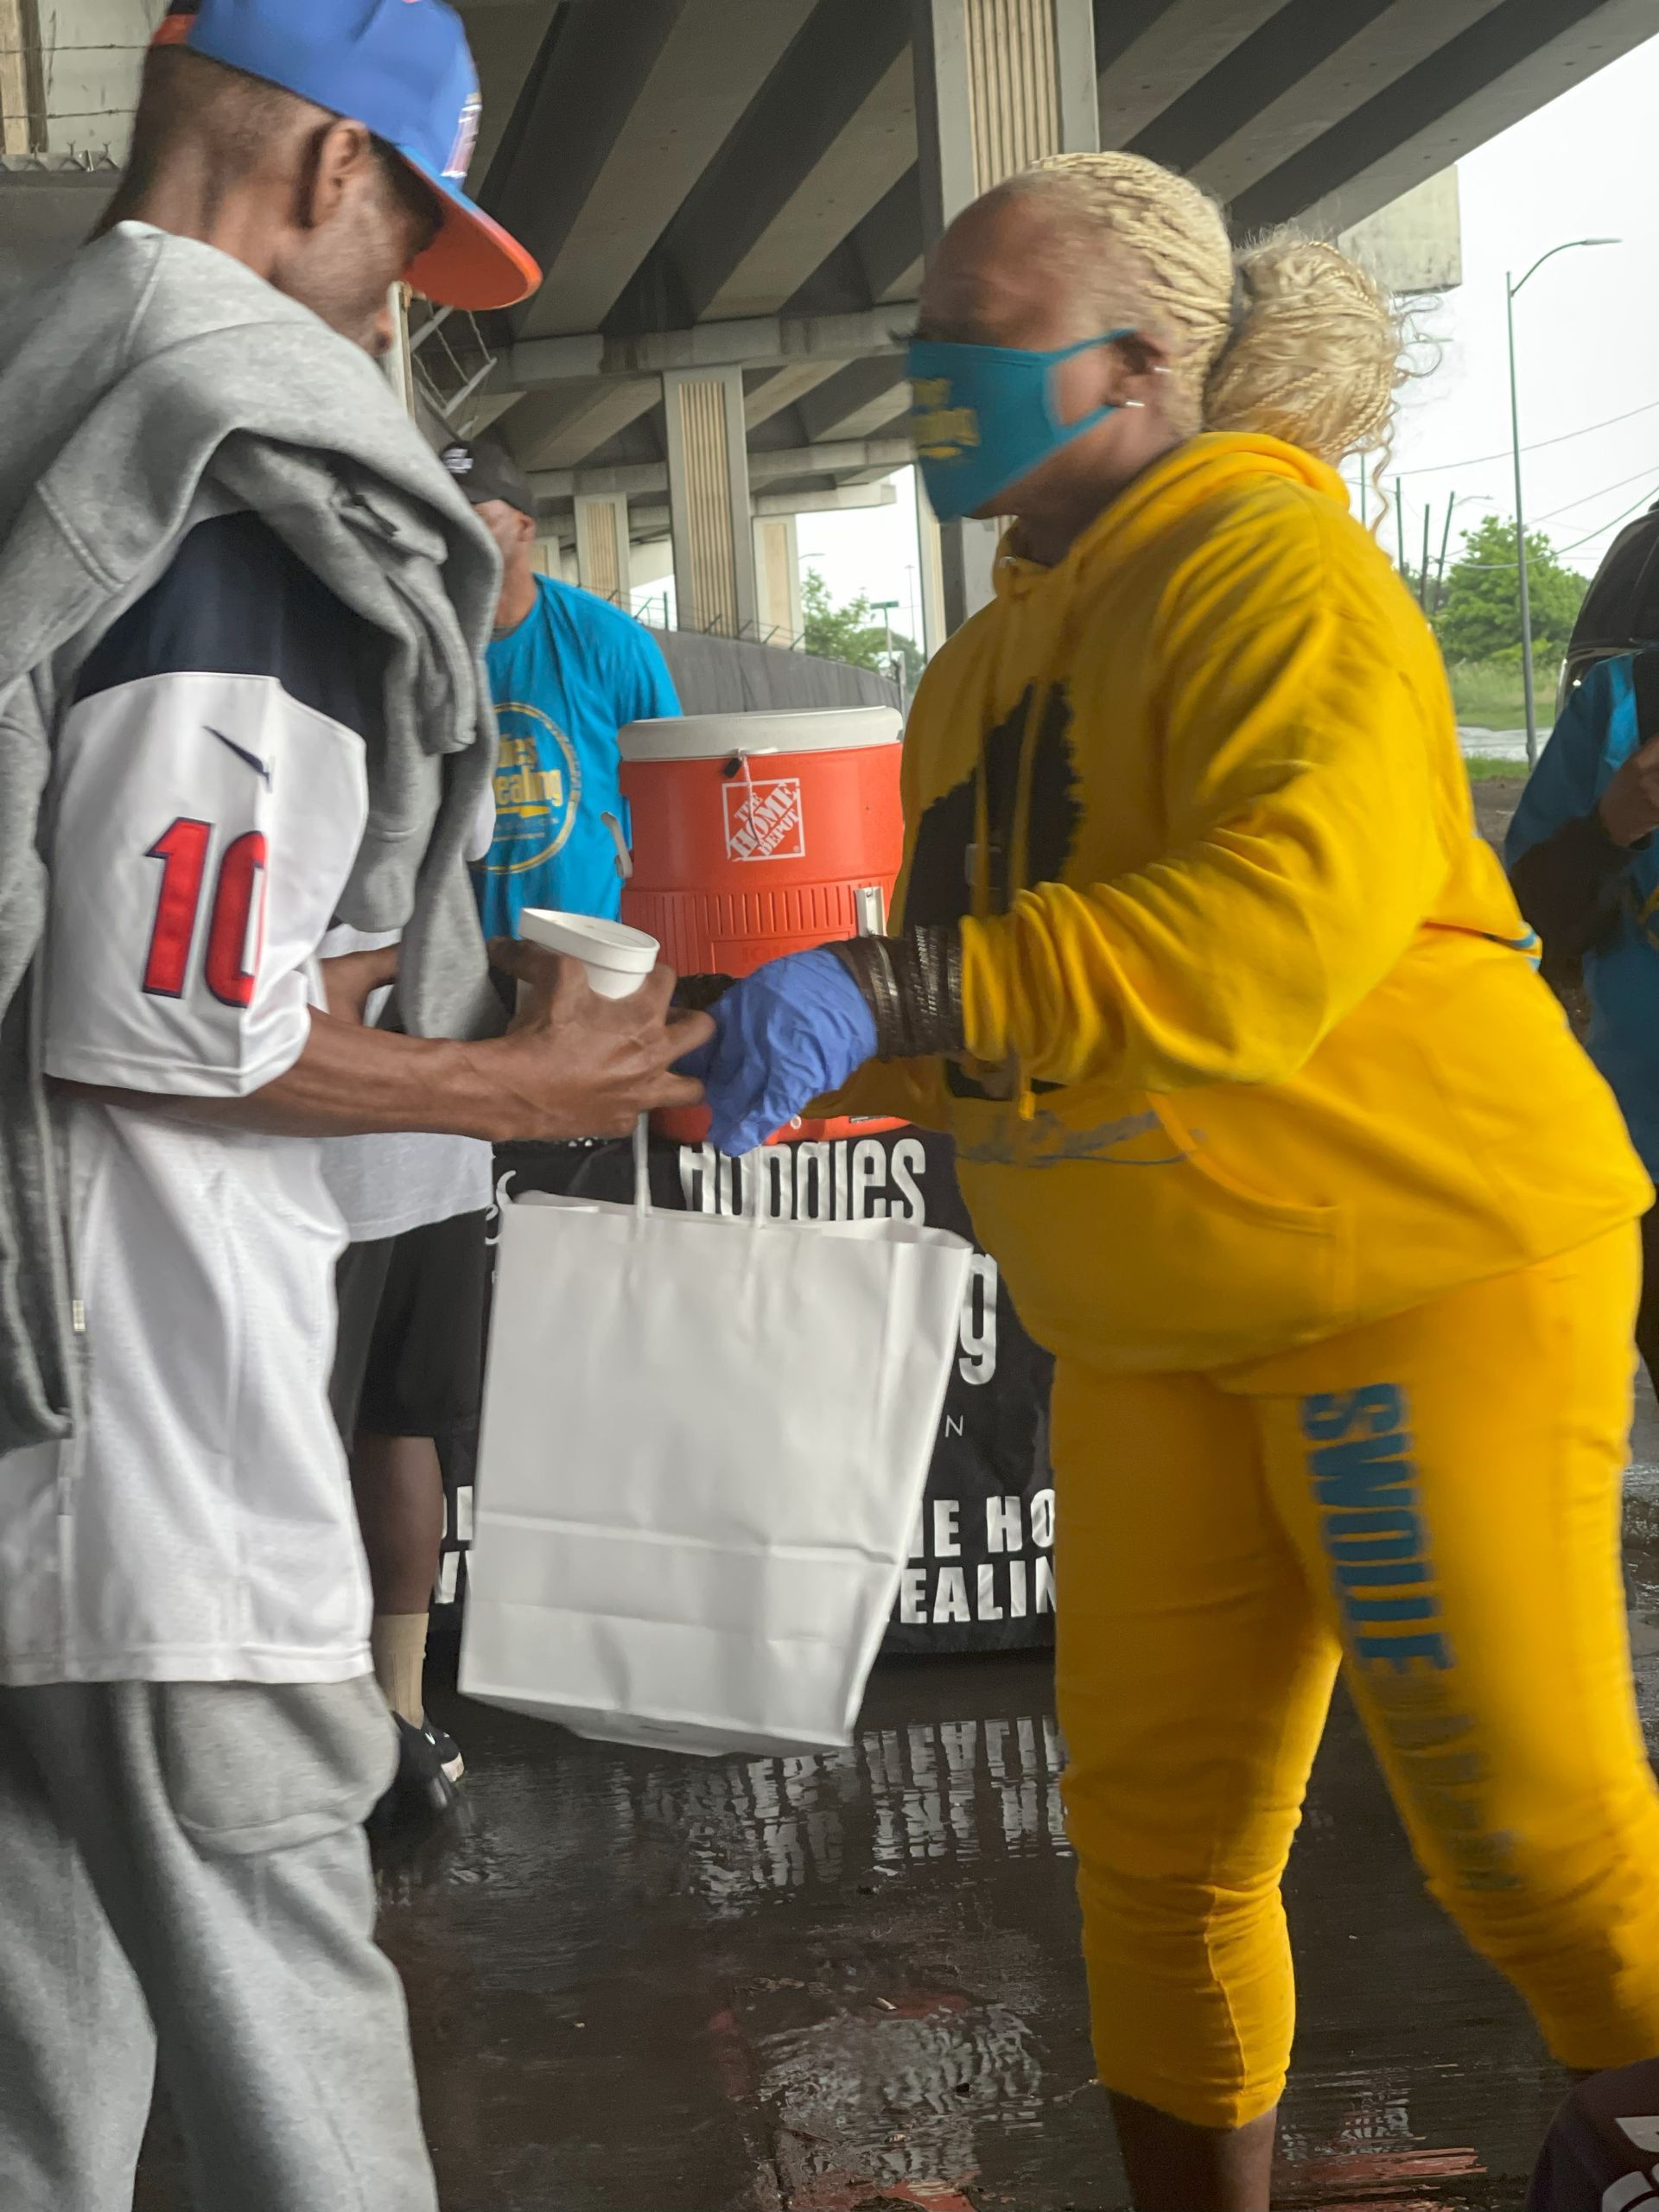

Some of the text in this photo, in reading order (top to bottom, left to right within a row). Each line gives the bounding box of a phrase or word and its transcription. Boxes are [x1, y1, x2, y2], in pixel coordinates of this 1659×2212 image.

[730, 782, 800, 858] HOME
[734, 792, 764, 822] THE
[757, 808, 800, 856] DEPOT
[986, 1488, 1056, 1554] HO
[899, 1555, 1057, 1624] EALIN
